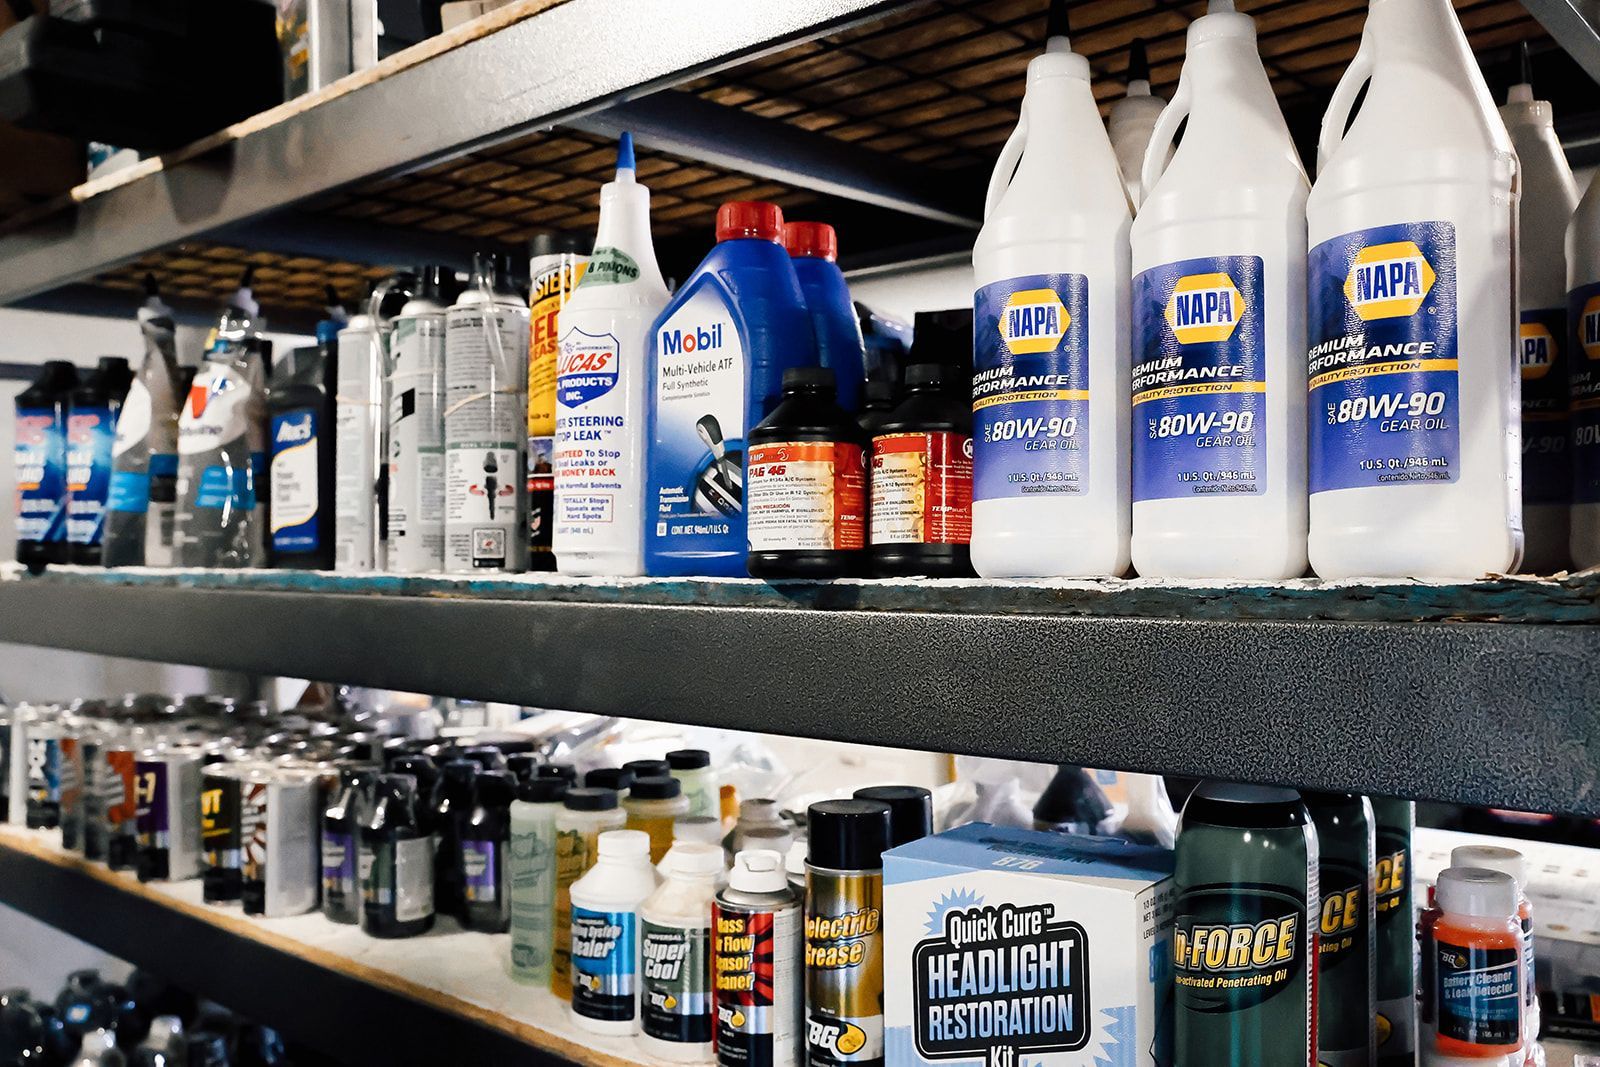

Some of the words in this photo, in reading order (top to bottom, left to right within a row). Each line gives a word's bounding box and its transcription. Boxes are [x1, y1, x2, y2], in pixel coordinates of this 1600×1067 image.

[597, 262, 638, 278] PINIONS
[1357, 262, 1420, 302] NAPA
[1176, 291, 1232, 326] NAPA
[1008, 306, 1058, 338] NAPA
[663, 323, 722, 355] Mobil
[1308, 334, 1365, 361] REMIUM
[663, 360, 716, 377] Multi-Vehicle
[718, 358, 733, 371] ATF
[1132, 356, 1183, 377] REMIUM
[1308, 341, 1435, 375] ERFORMANCE
[972, 366, 1014, 386] EMIUM
[1132, 365, 1246, 391] ERFORMANCE
[1343, 362, 1421, 378] PROTECTION
[562, 376, 613, 388] PRODUCTS
[662, 382, 675, 391] Full
[677, 378, 708, 392] Synthetic
[972, 374, 1069, 399] RFORMANCE
[1163, 384, 1233, 396] PROTECTION
[565, 391, 583, 401] INC.
[996, 392, 1058, 402] PROTECTION
[1327, 402, 1336, 425] SAE
[1337, 391, 1446, 423] 80W-90
[568, 416, 624, 428] STEERING
[991, 417, 1078, 442] 80W-90
[1149, 418, 1157, 440] SAE
[1157, 411, 1254, 438] 80W-90
[1380, 419, 1422, 433] GEAR
[1425, 418, 1449, 430] OIL
[1024, 440, 1056, 451] GEAR
[1060, 440, 1079, 450] OIL
[1196, 436, 1232, 448] GEAR
[1235, 435, 1256, 447] OIL
[570, 459, 595, 468] Leaks
[585, 449, 595, 458] To
[598, 449, 620, 459] Stop
[1366, 459, 1386, 470] U.S.
[1388, 457, 1429, 470] Qt./946
[1431, 456, 1448, 467] mL
[589, 468, 616, 477] BACK
[749, 467, 765, 478] PAG
[767, 465, 786, 476] 46
[1013, 473, 1029, 482] U.S.
[1064, 472, 1078, 481] mL
[1183, 472, 1201, 482] U.S.
[1202, 471, 1239, 482] Qt./946
[1240, 471, 1256, 480] mL
[589, 497, 609, 505] Stops
[950, 910, 998, 948] Quick
[572, 937, 616, 959] ealer
[643, 939, 691, 962] Super
[1174, 914, 1297, 970] n-FORCE
[645, 958, 682, 981] Cool
[928, 939, 1075, 1000] HEADLIGHT
[1216, 972, 1272, 988] Penetrating
[1274, 969, 1288, 982] Oil
[1443, 975, 1475, 989] Battery
[1476, 971, 1513, 985] Cleaner
[1474, 983, 1514, 997] Detector
[928, 993, 1074, 1042] RESTORATION
[808, 1020, 840, 1052] BG
[990, 1045, 1015, 1067] Kit
